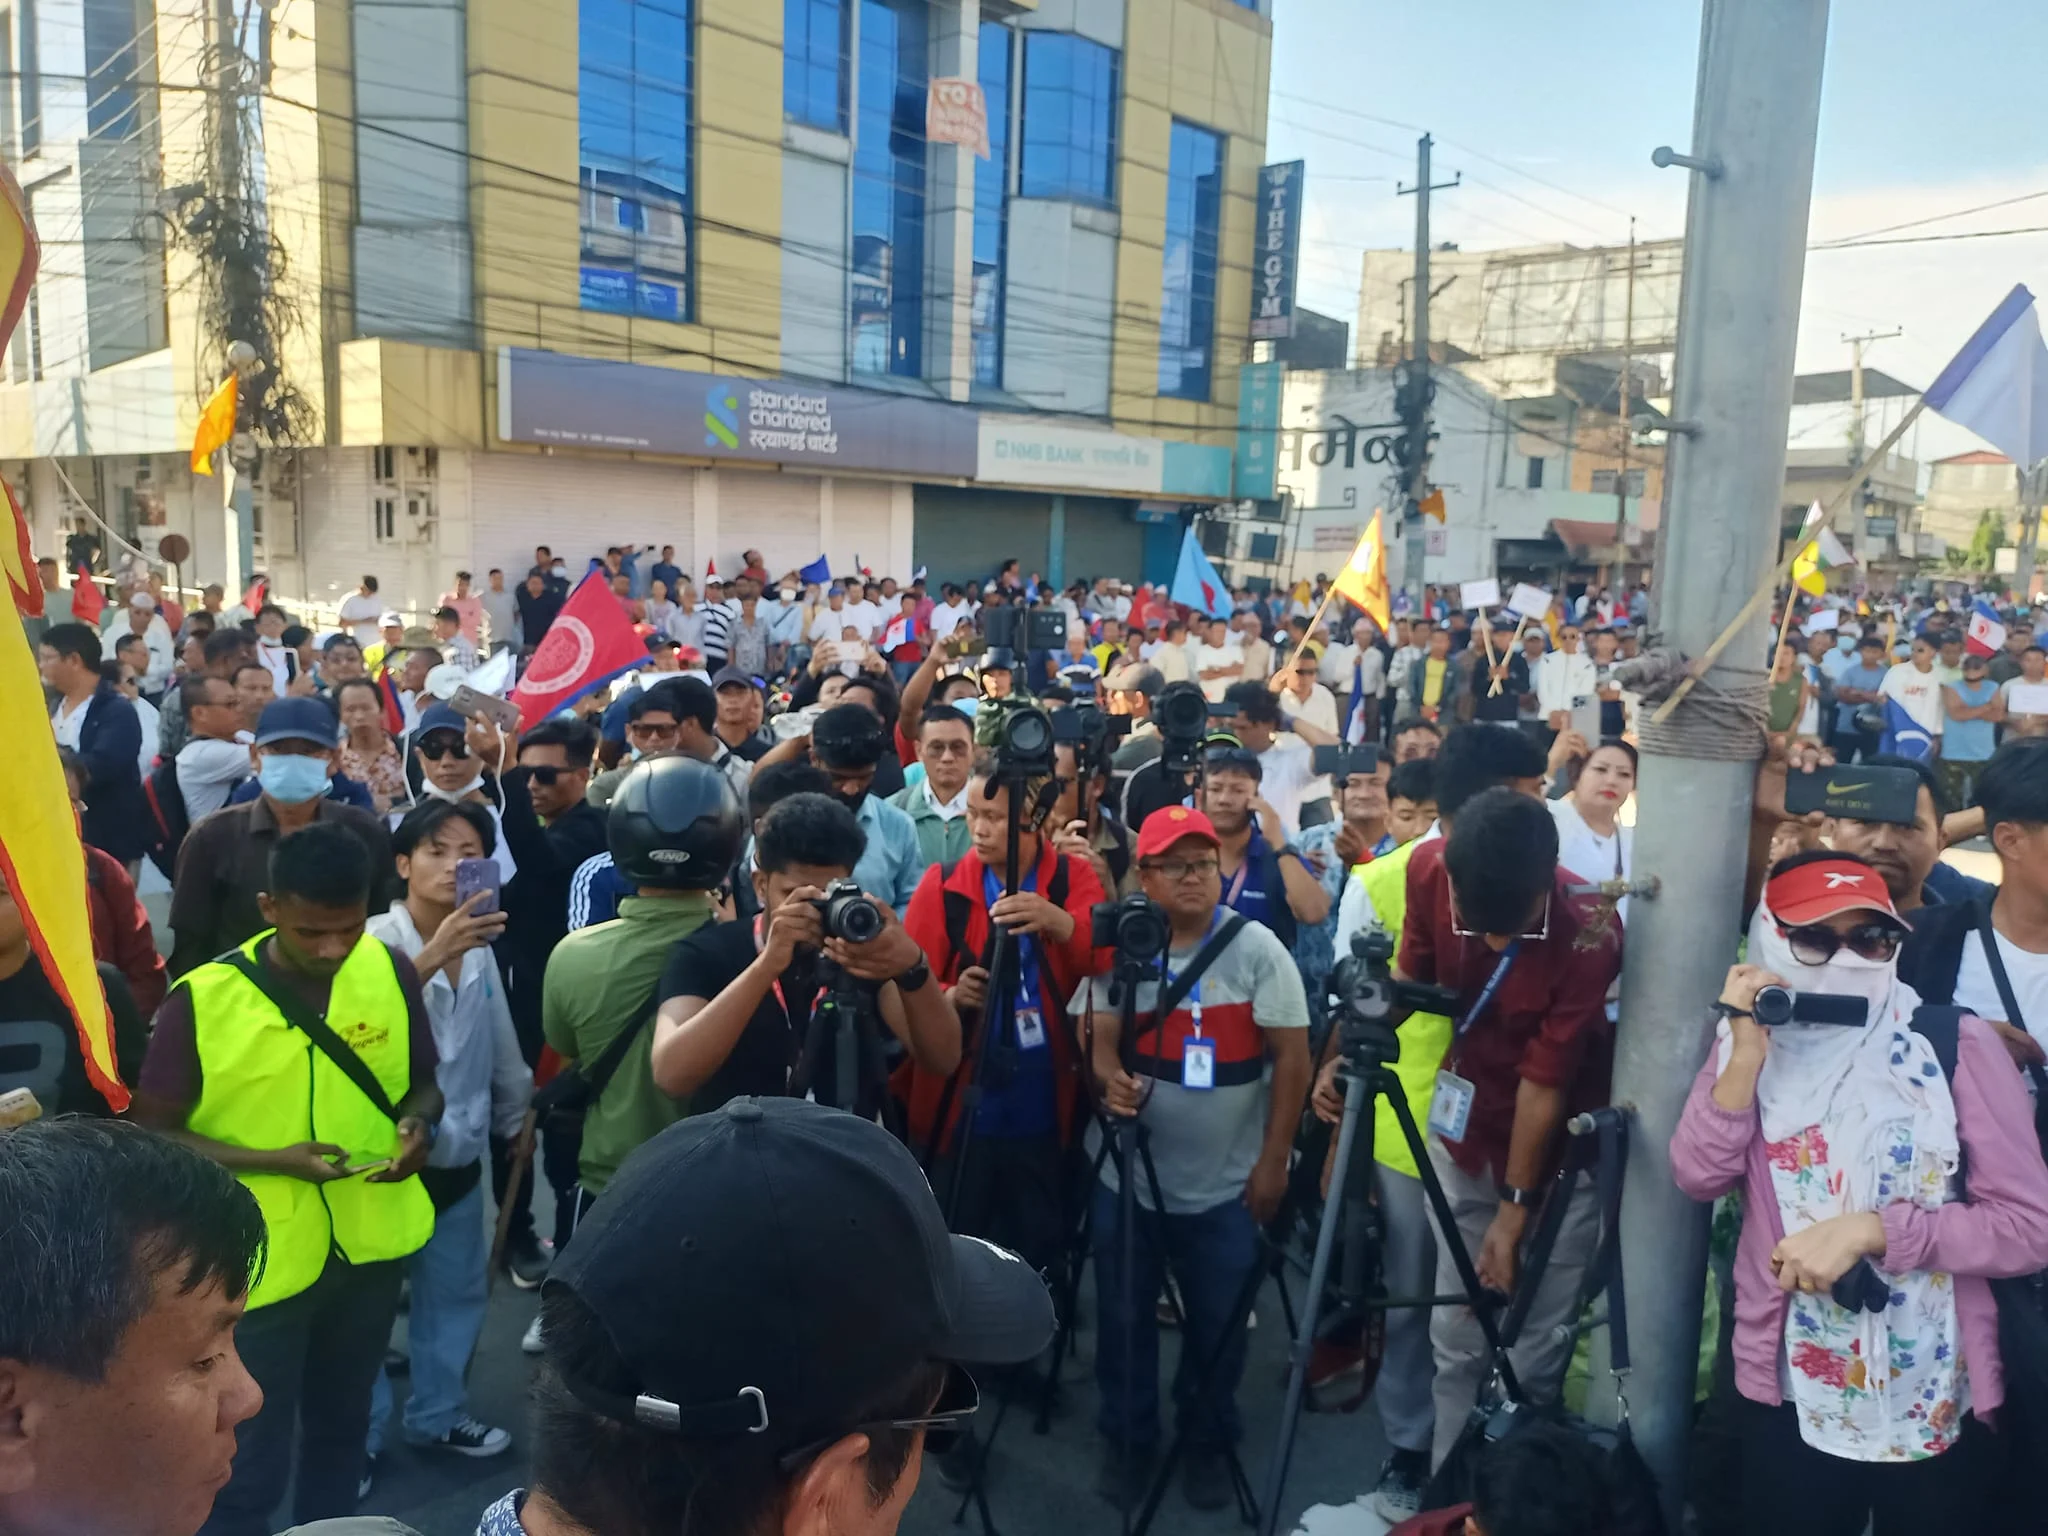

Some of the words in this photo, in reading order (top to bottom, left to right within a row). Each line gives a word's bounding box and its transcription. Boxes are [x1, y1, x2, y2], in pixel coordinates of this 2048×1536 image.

[1259, 254, 1283, 317] GYM
[749, 389, 828, 414] standard
[749, 407, 832, 432] chartered
